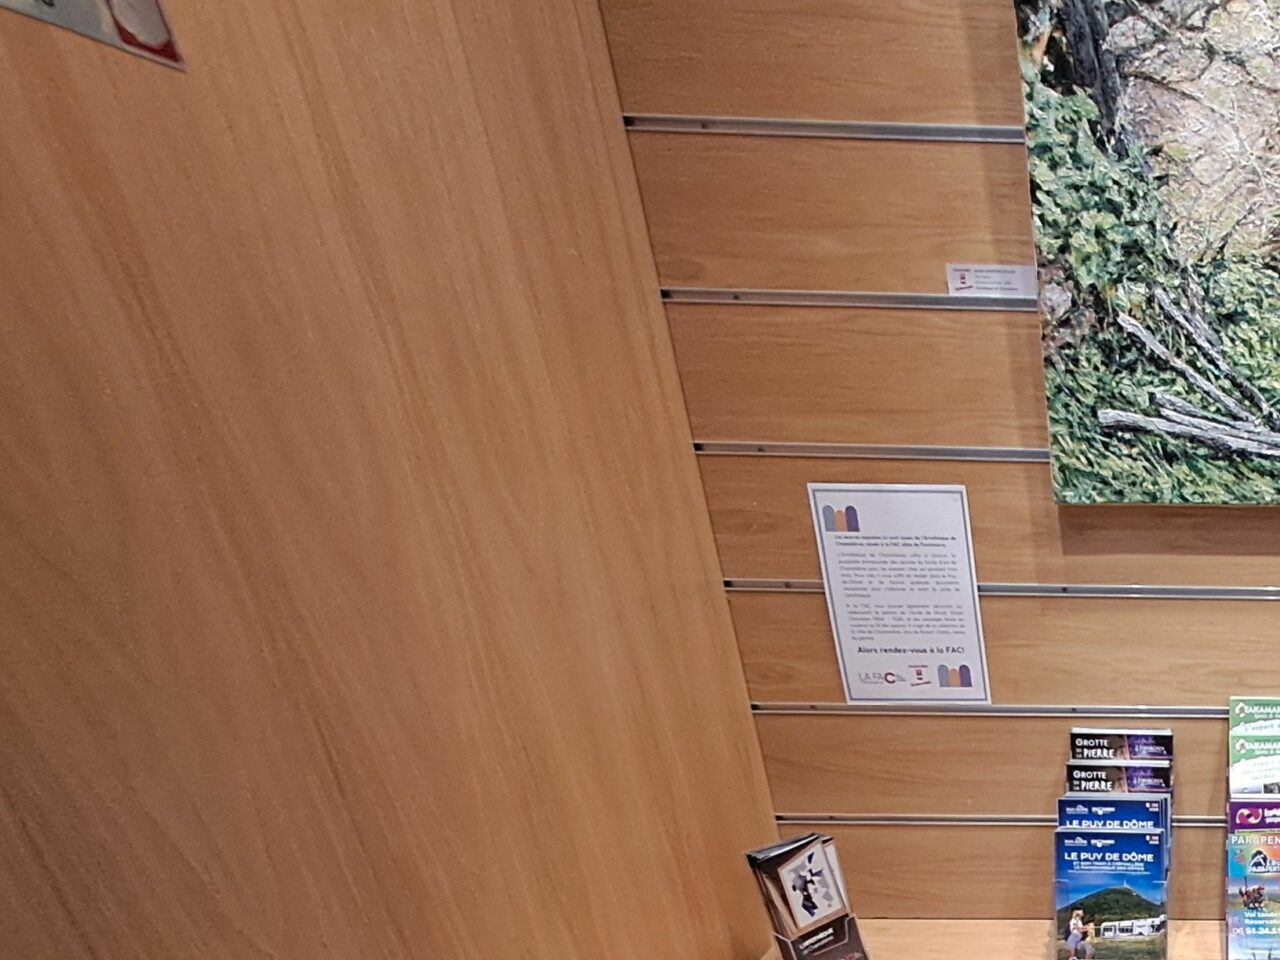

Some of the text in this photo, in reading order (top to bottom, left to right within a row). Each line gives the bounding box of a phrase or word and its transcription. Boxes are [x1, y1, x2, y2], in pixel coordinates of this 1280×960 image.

[857, 646, 878, 655] Alors
[879, 646, 927, 655] rendez-vous
[929, 645, 935, 655] à
[936, 646, 944, 655] la
[1083, 748, 1115, 759] PIERRE
[1081, 780, 1113, 791] PIERRE
[1066, 818, 1155, 829] LE PUY DE DÔME
[1064, 851, 1154, 862] LE PUY DE DÔME
